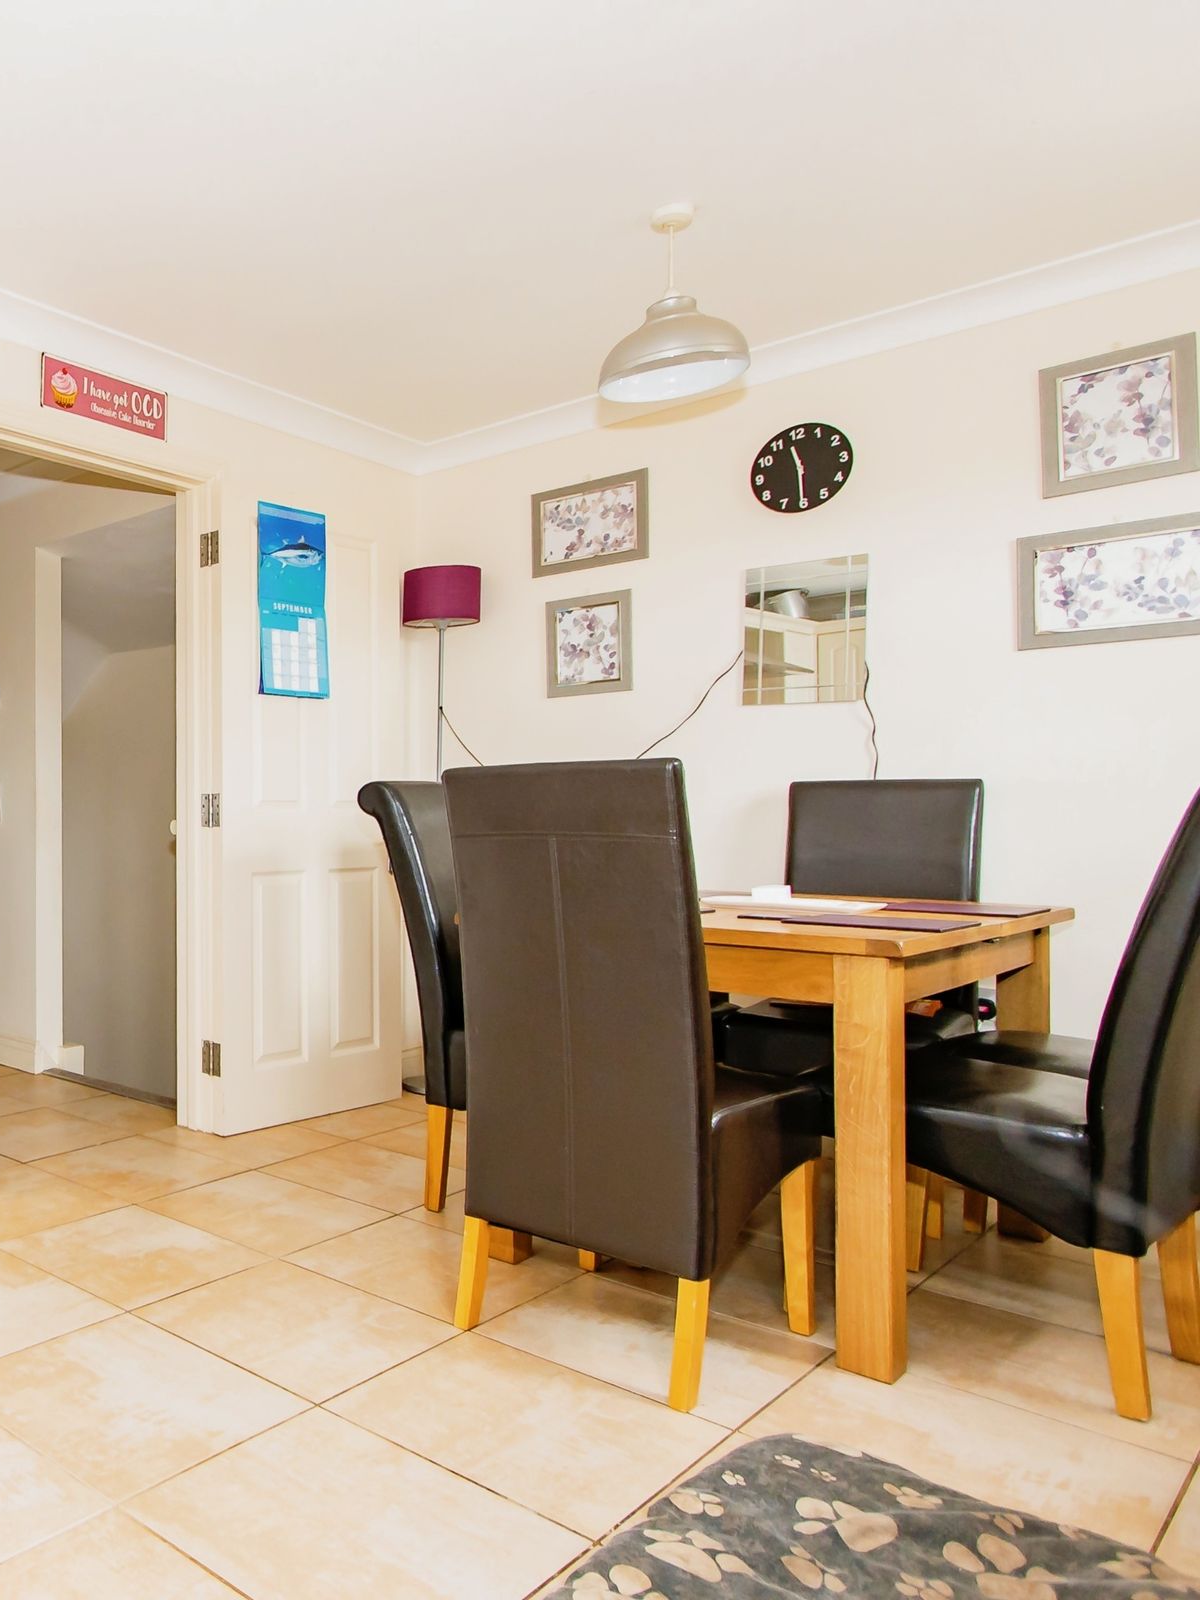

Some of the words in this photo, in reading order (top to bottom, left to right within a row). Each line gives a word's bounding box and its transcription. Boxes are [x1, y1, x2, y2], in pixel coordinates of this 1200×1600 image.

[83, 377, 88, 394] I
[90, 380, 112, 402] have
[113, 391, 129, 410] got
[131, 391, 163, 420] OCD
[90, 402, 117, 419] Obsessive
[118, 411, 132, 424] Cake
[133, 415, 156, 430] Disorder
[788, 427, 806, 441] 12
[813, 427, 821, 439] 1
[770, 438, 784, 452] 11
[830, 434, 841, 447] 2
[757, 455, 773, 468] 10
[839, 451, 849, 463] 3
[755, 474, 764, 486] 9
[833, 471, 844, 483] 4
[761, 490, 772, 501] 8
[819, 487, 829, 499] 5
[779, 497, 789, 510] 7
[798, 497, 809, 509] 6
[273, 602, 313, 614] SEPTEMBER
